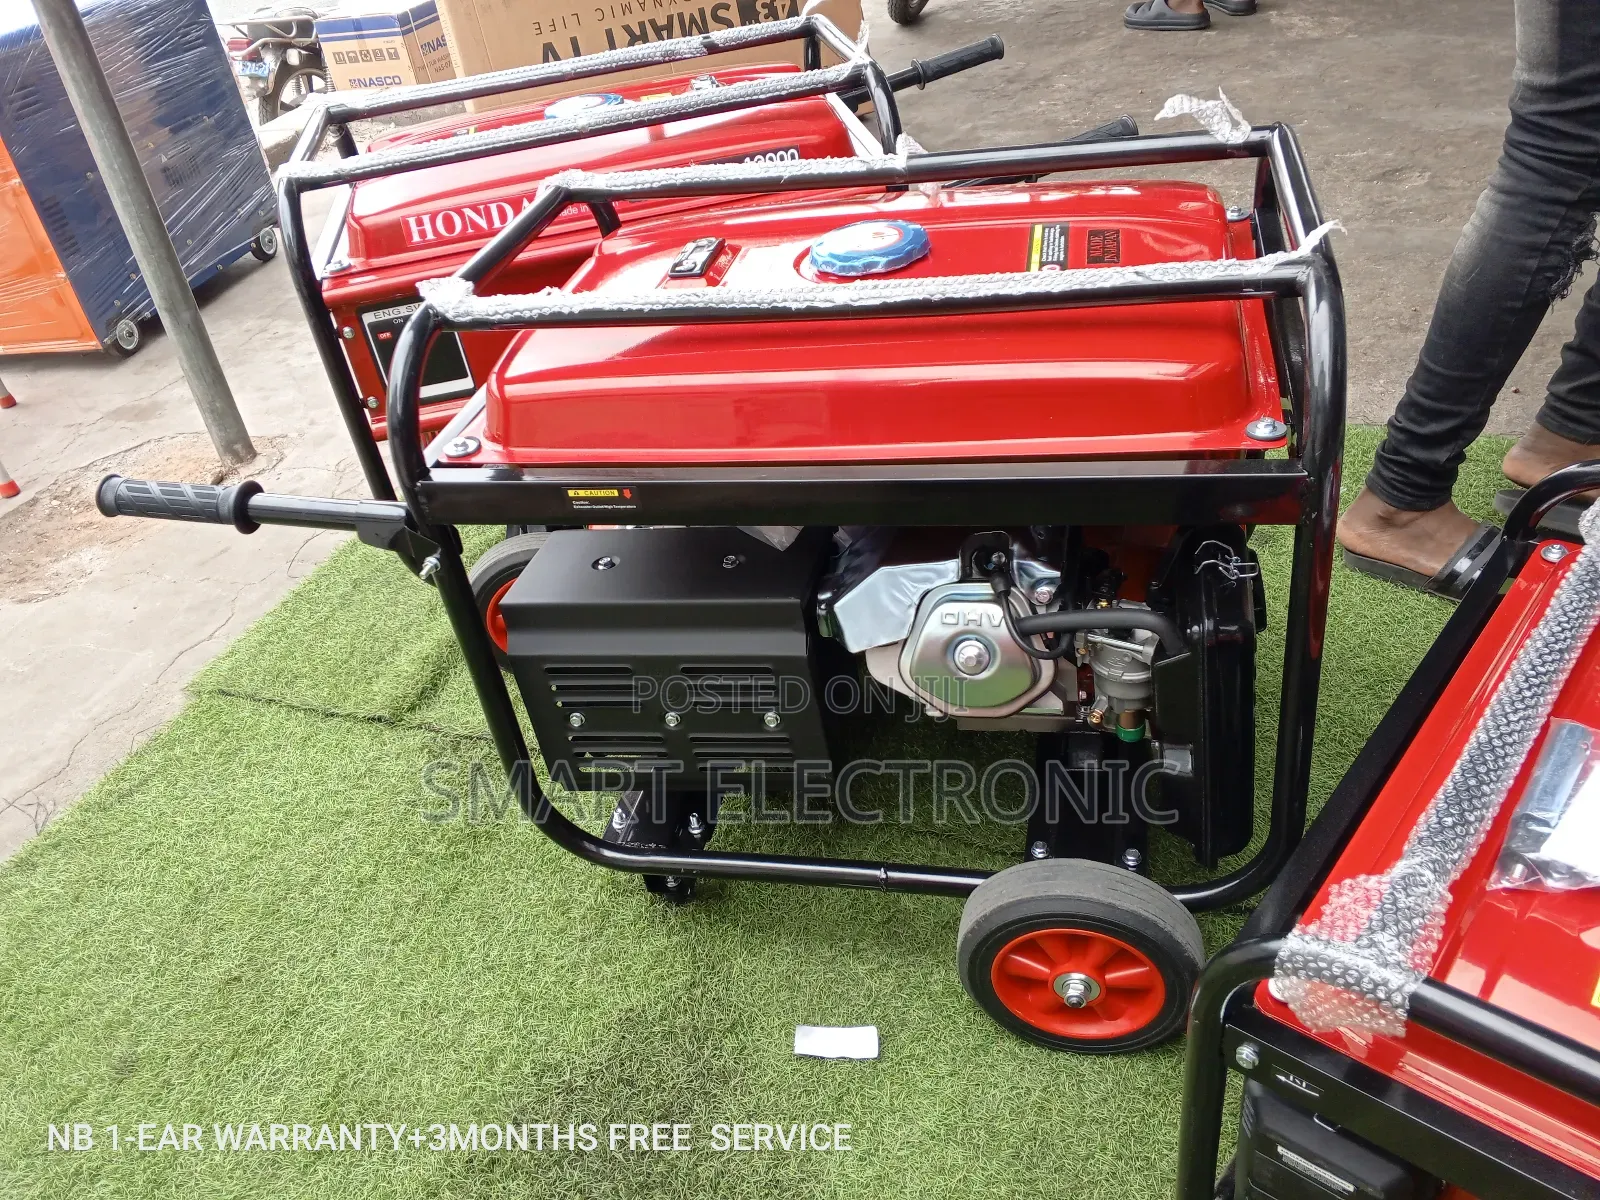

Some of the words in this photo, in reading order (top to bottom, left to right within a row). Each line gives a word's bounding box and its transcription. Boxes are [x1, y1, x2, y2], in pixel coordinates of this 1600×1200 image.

[532, 12, 581, 36] LIFE
[358, 75, 402, 88] NASCO
[1090, 235, 1103, 257] MADE
[1104, 231, 1117, 253] JAPAN
[941, 611, 1004, 628] OHV
